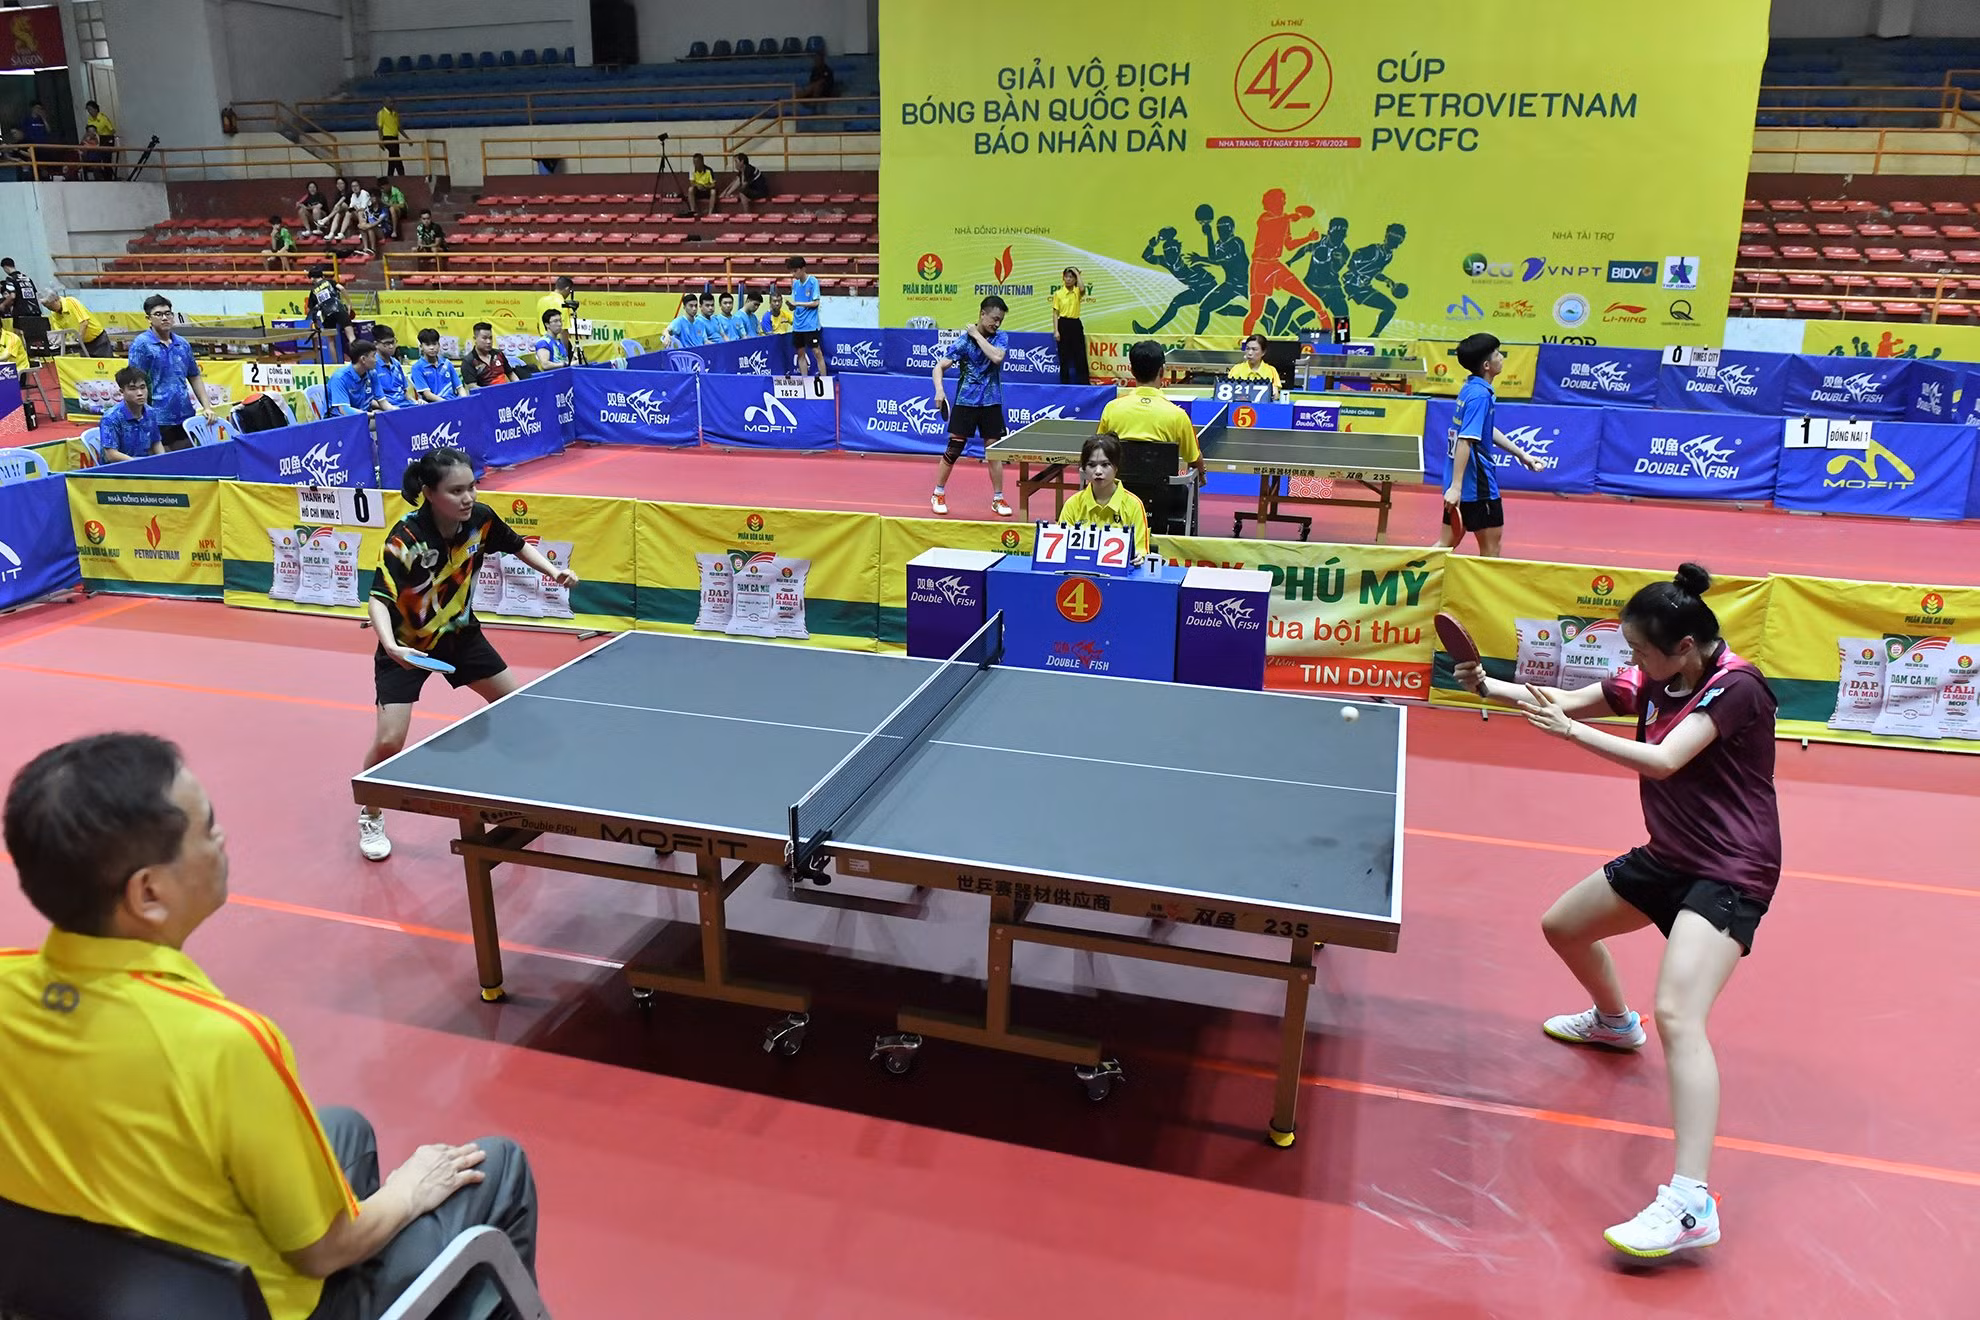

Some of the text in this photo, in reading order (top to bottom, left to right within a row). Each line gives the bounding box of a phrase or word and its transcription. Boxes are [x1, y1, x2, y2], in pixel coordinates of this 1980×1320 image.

[997, 57, 1190, 91] GIẢI VÔ ĐỊCH
[1376, 50, 1445, 83] CÚP
[1243, 45, 1313, 109] 42
[902, 86, 1188, 125] BÓNG BÀN QUỐC GIA
[1373, 92, 1637, 118] PETROVIETNAM
[974, 121, 1187, 155] BÁO NHÂN DÂN
[1371, 127, 1479, 152] PVCFC
[954, 226, 972, 235] NHÀ
[999, 226, 1022, 235] HÀNH
[1023, 225, 1050, 235] CHÍNH
[1552, 231, 1615, 241] NHÀ TÀI TRỢ
[1472, 262, 1514, 277] BCG
[1548, 266, 1602, 276] VNPT
[1611, 268, 1643, 280] BIDV
[974, 284, 1033, 296] PETROVIETNAM
[1089, 342, 1118, 357] NPK
[831, 357, 884, 367] DOUBLE FISH
[906, 358, 936, 367] DOUBLE
[1708, 353, 1718, 362] CITY
[1003, 362, 1060, 373] DOUBLE FISH
[1091, 361, 1113, 371] Cho
[251, 366, 259, 383] 2
[1560, 377, 1630, 392] DOUBLE FISH
[1686, 380, 1757, 396] DOUBLE FISH
[1217, 384, 1233, 401] 8
[1235, 385, 1243, 394] 2
[1252, 385, 1268, 403] 7
[1811, 390, 1884, 403] DOUBLE FISH
[600, 410, 670, 424] DOUBLE FISH
[1238, 408, 1252, 427] 5
[495, 422, 542, 442] DOUBLE FISH
[745, 425, 797, 433] MOFIT
[866, 417, 945, 434] DOUBLE FISH
[1801, 418, 1810, 444] 1
[1830, 428, 1849, 441] ĐỒNG
[1850, 431, 1863, 441] NAI
[1634, 458, 1739, 479] DOUBLE FISH
[327, 470, 349, 487] FISH
[1823, 479, 1915, 490] MOFIT
[323, 492, 335, 503] PHỐ
[320, 509, 335, 519] MINH
[199, 540, 216, 549] NPK
[1043, 533, 1064, 559] 7
[1071, 533, 1081, 546] 2
[1101, 537, 1125, 564] 2
[134, 549, 180, 560] PETROVIETNAM
[1147, 558, 1159, 572] T
[1257, 557, 1430, 607] PHÚ MỸ
[709, 589, 730, 597] DAP
[776, 593, 798, 601] KALI
[911, 592, 976, 606] Double FISH
[1063, 582, 1089, 617] 4
[1186, 616, 1260, 631] Double FISH
[1267, 615, 1421, 646] ùa bội thu
[1046, 655, 1109, 671] DOUBLE FISH
[1527, 660, 1554, 668] DAP
[1300, 664, 1423, 690] TIN DÙNG
[1850, 681, 1878, 689] DAP
[1943, 685, 1975, 694] KALI
[521, 819, 577, 834] Double FISH
[601, 824, 748, 859] MOFIT
[957, 875, 1111, 912] 世乒赛器材供应商
[1192, 908, 1237, 929] 双鱼
[1264, 919, 1309, 938] 235
